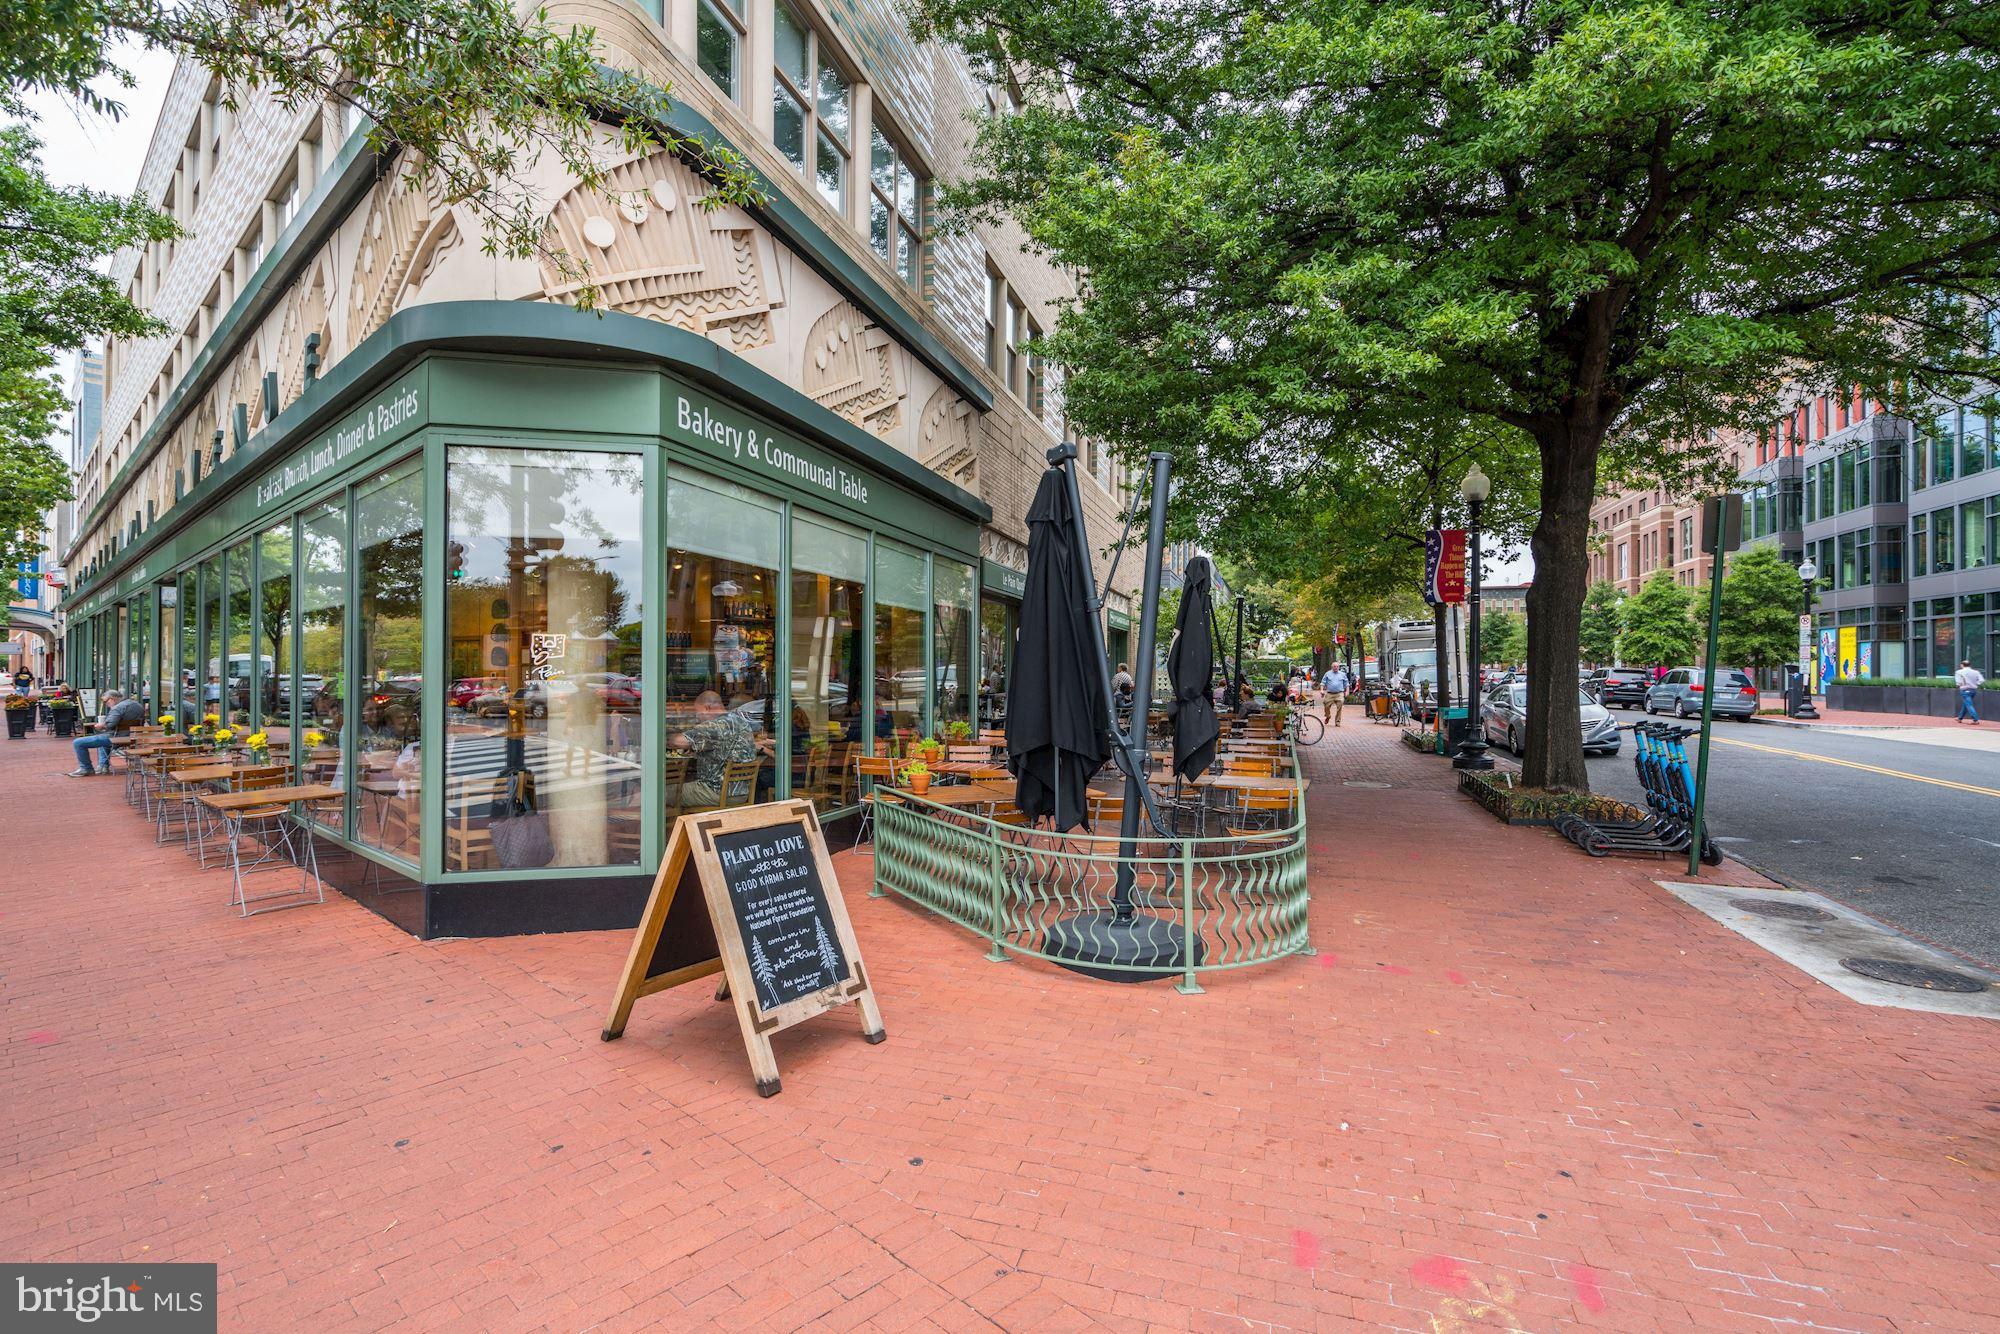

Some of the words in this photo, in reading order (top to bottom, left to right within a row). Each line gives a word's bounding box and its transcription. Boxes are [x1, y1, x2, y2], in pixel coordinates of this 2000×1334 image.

[257, 476, 284, 507] Breakfast,
[284, 462, 310, 491] Brunch,
[310, 439, 336, 475] Lunch,
[336, 424, 366, 460] Dinner
[367, 411, 375, 441] &
[378, 387, 418, 436] Pastries
[677, 396, 743, 458] Bakery
[748, 428, 760, 460] &
[764, 436, 836, 491] Communal
[838, 470, 868, 504] Table
[1002, 572, 1007, 586] Le
[531, 664, 566, 680] Pain
[721, 844, 762, 866] PLANT
[774, 835, 804, 854] LOVE
[749, 860, 772, 875] with
[772, 857, 788, 868] the
[735, 878, 758, 893] GOOD
[760, 872, 784, 886] KARMA
[786, 865, 808, 880] SALAD
[744, 912, 754, 922] we
[754, 910, 764, 920] will
[765, 906, 778, 917] plant
[784, 901, 794, 910] tree
[794, 898, 806, 907] with
[806, 895, 815, 903] the
[747, 900, 757, 910] For
[758, 897, 773, 908] every
[774, 892, 787, 902] salad
[788, 887, 807, 898] ordered
[749, 918, 772, 931] National
[772, 912, 789, 924] Forest
[788, 906, 816, 918] Foundation
[768, 936, 787, 946] come
[798, 927, 810, 935] in
[784, 940, 802, 953] and
[773, 954, 796, 972] plant
